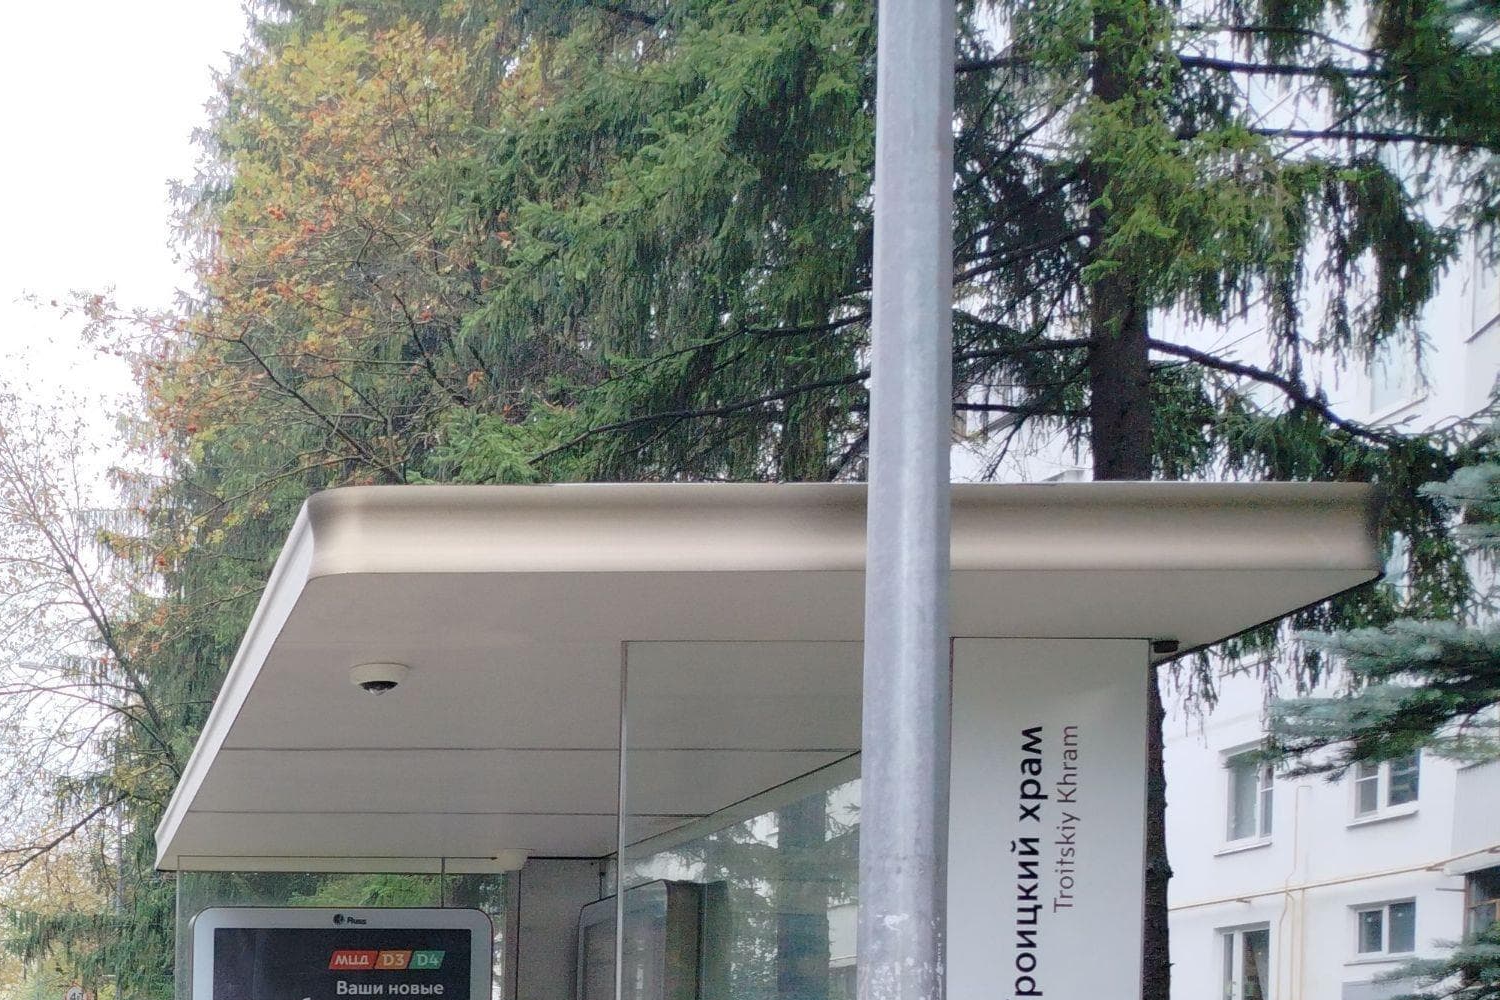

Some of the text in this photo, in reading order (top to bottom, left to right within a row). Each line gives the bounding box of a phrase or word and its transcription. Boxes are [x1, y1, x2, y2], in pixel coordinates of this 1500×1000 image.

[1019, 726, 1048, 822] храм
[1053, 725, 1081, 913] Troitskiy Khram
[382, 953, 405, 966] D3
[417, 953, 439, 966] D4
[336, 980, 444, 995] Ваши новые
